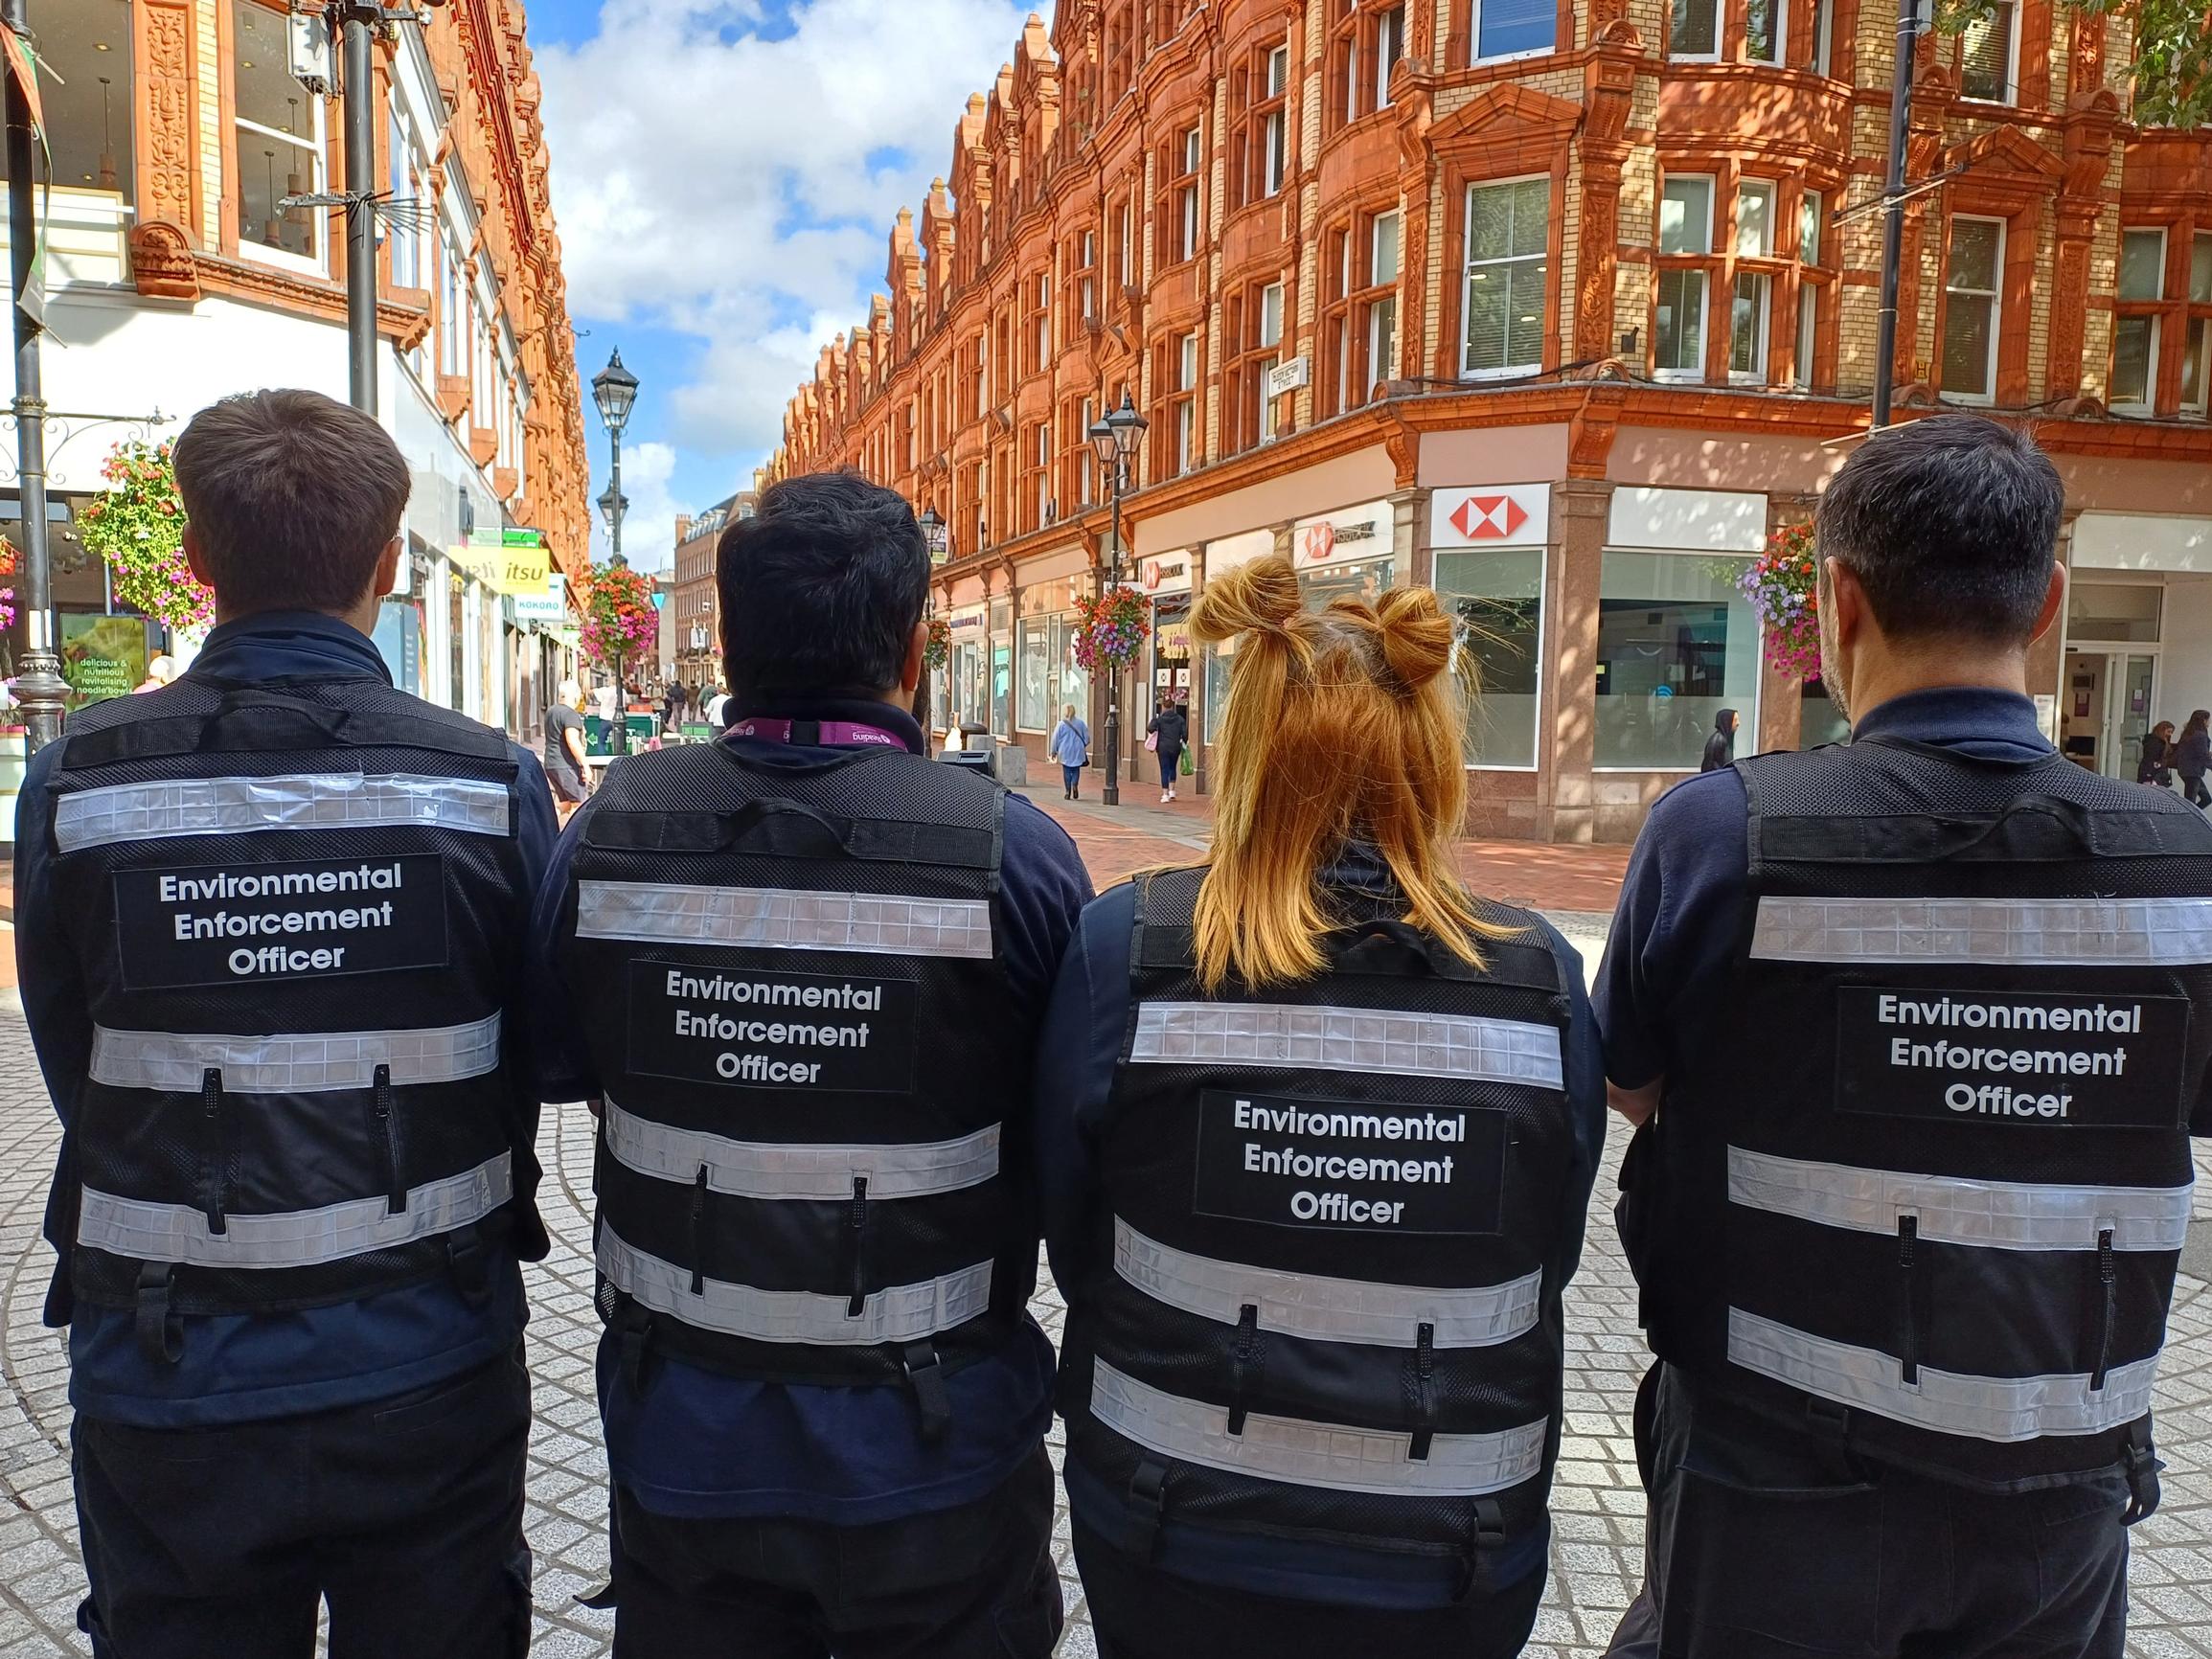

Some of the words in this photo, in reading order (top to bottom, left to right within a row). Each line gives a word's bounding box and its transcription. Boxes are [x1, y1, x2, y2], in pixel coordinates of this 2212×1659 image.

[506, 562, 543, 580] itsu
[518, 601, 559, 611] KOKORO
[80, 658, 118, 668] delicious
[120, 659, 127, 668] &
[83, 668, 125, 676] nutritious
[81, 676, 127, 687] revitalising
[852, 732, 882, 743] Reading
[159, 862, 402, 902] Environmental
[174, 900, 394, 941] Enforcement
[228, 945, 346, 975] Officer
[666, 970, 882, 1011] Environmental
[675, 1010, 870, 1049] Enforcement
[1878, 994, 2142, 1034] Environmental
[716, 1053, 822, 1084] Officer
[1890, 1037, 2128, 1077] Enforcement
[1944, 1083, 2073, 1118] Officer
[1234, 1100, 1466, 1143] Environmental
[1244, 1143, 1455, 1184] Enforcement
[1290, 1191, 1405, 1224] Officer
